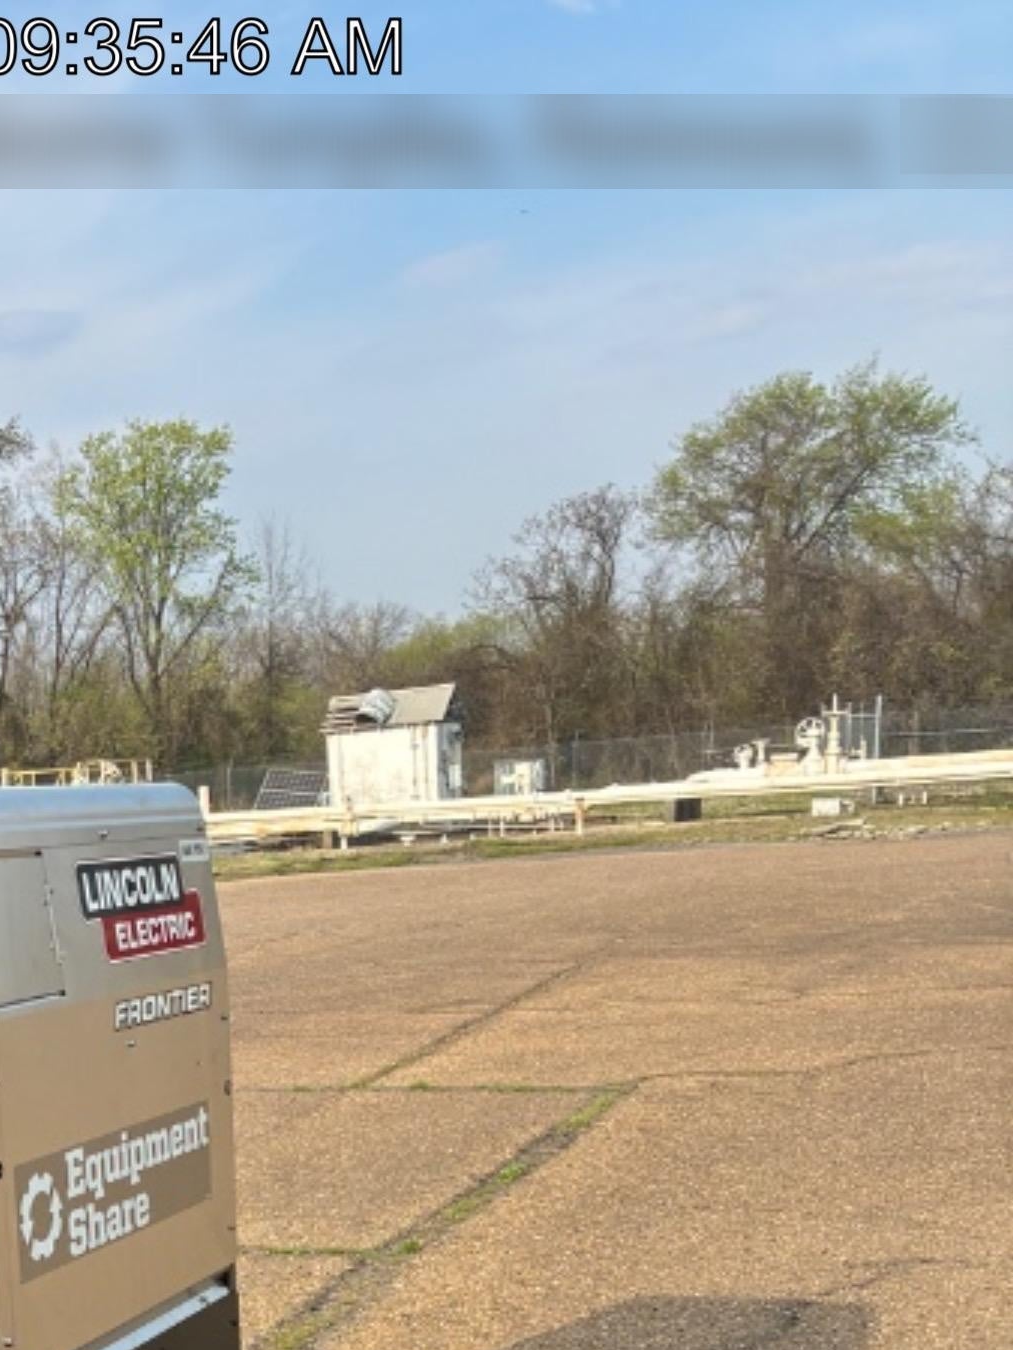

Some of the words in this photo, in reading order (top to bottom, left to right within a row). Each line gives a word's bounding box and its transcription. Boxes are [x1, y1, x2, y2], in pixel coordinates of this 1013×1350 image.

[81, 863, 181, 913] LINCOLN
[114, 910, 196, 952] ELECTRIC
[114, 982, 212, 1031] FRONTIER
[64, 1105, 210, 1200] Equipment
[68, 1191, 151, 1257] Share
